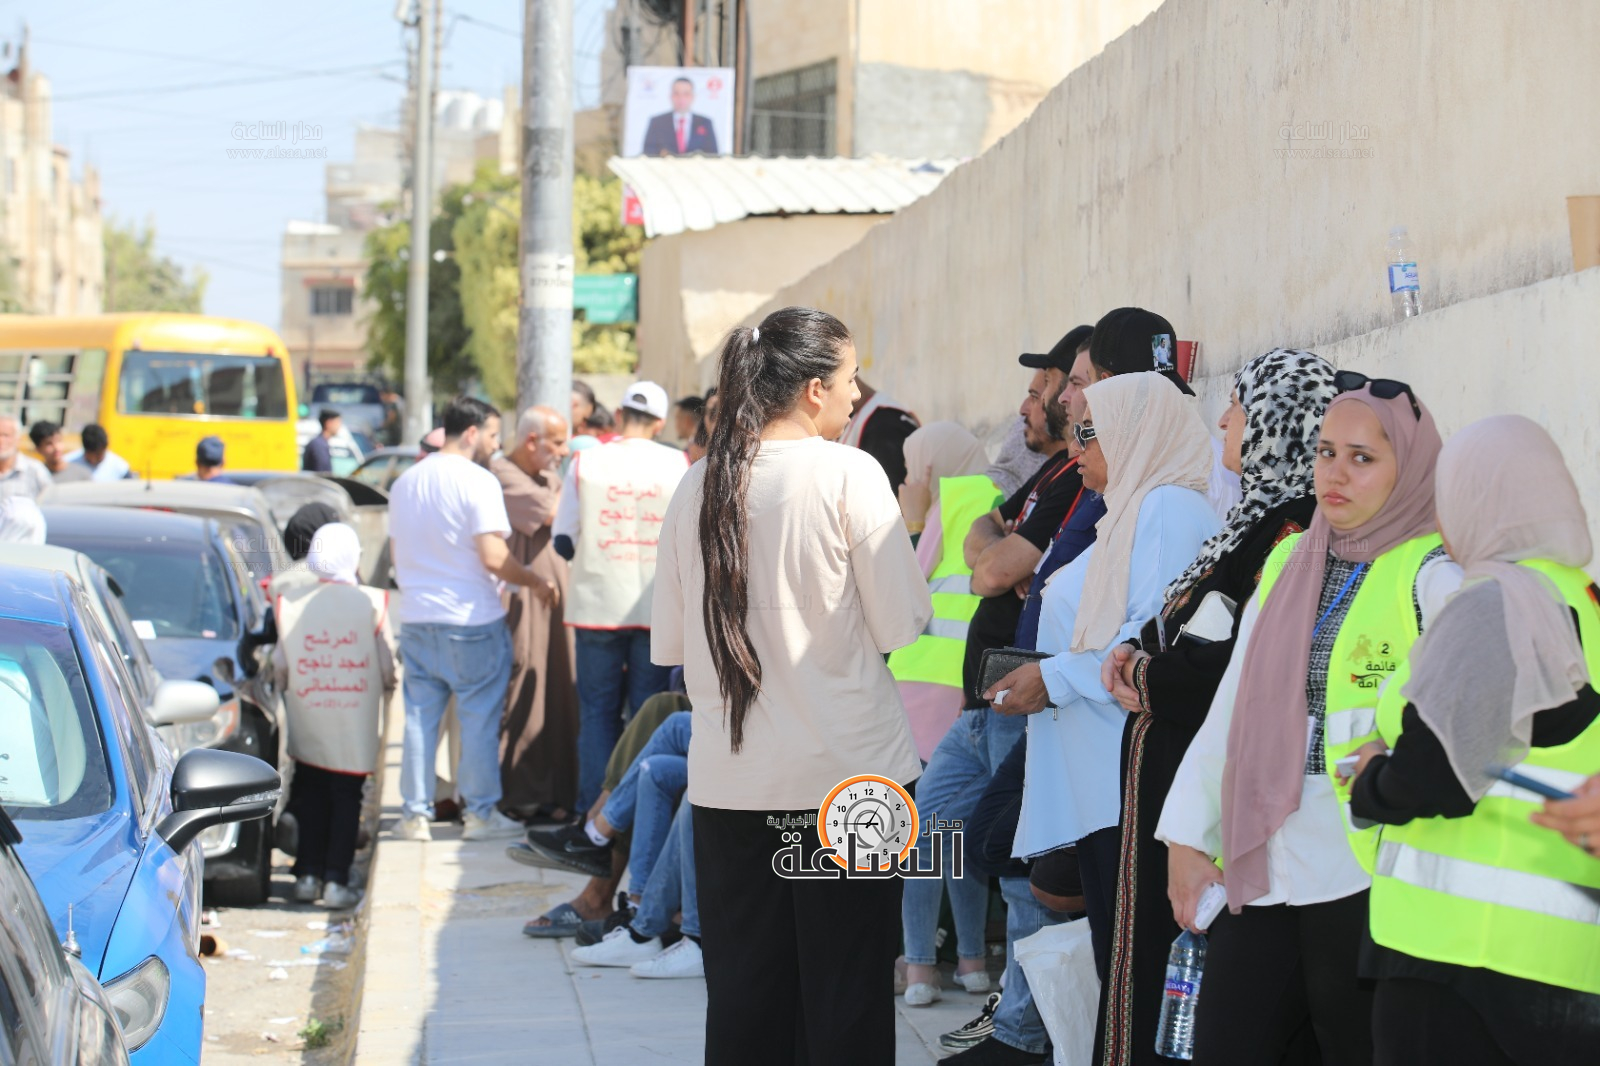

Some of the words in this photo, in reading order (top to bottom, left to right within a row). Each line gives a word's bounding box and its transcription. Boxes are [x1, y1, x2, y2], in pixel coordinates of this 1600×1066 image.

[303, 629, 358, 653] المرشح
[1381, 643, 1389, 655] 2
[296, 654, 332, 676] ناجح
[1365, 660, 1396, 672] قائمة
